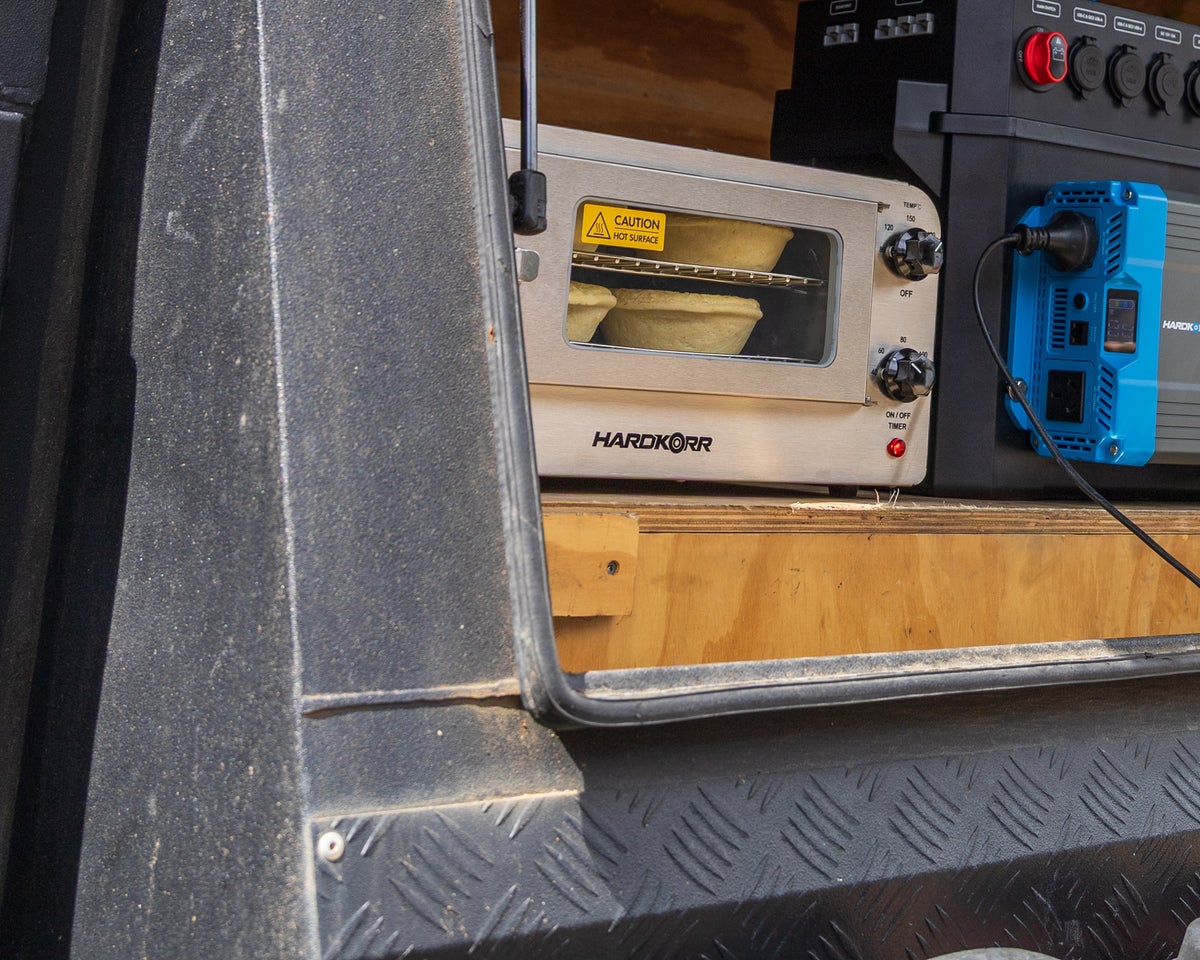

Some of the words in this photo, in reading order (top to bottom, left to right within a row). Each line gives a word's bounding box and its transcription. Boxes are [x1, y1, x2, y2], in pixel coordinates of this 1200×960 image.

[614, 215, 660, 230] CAUTION
[907, 215, 916, 223] 150
[613, 232, 627, 241] HOT
[629, 233, 659, 245] SURFACE
[900, 289, 913, 298] OFF
[888, 422, 907, 430] TIMER
[592, 431, 713, 454] HARDKORR
